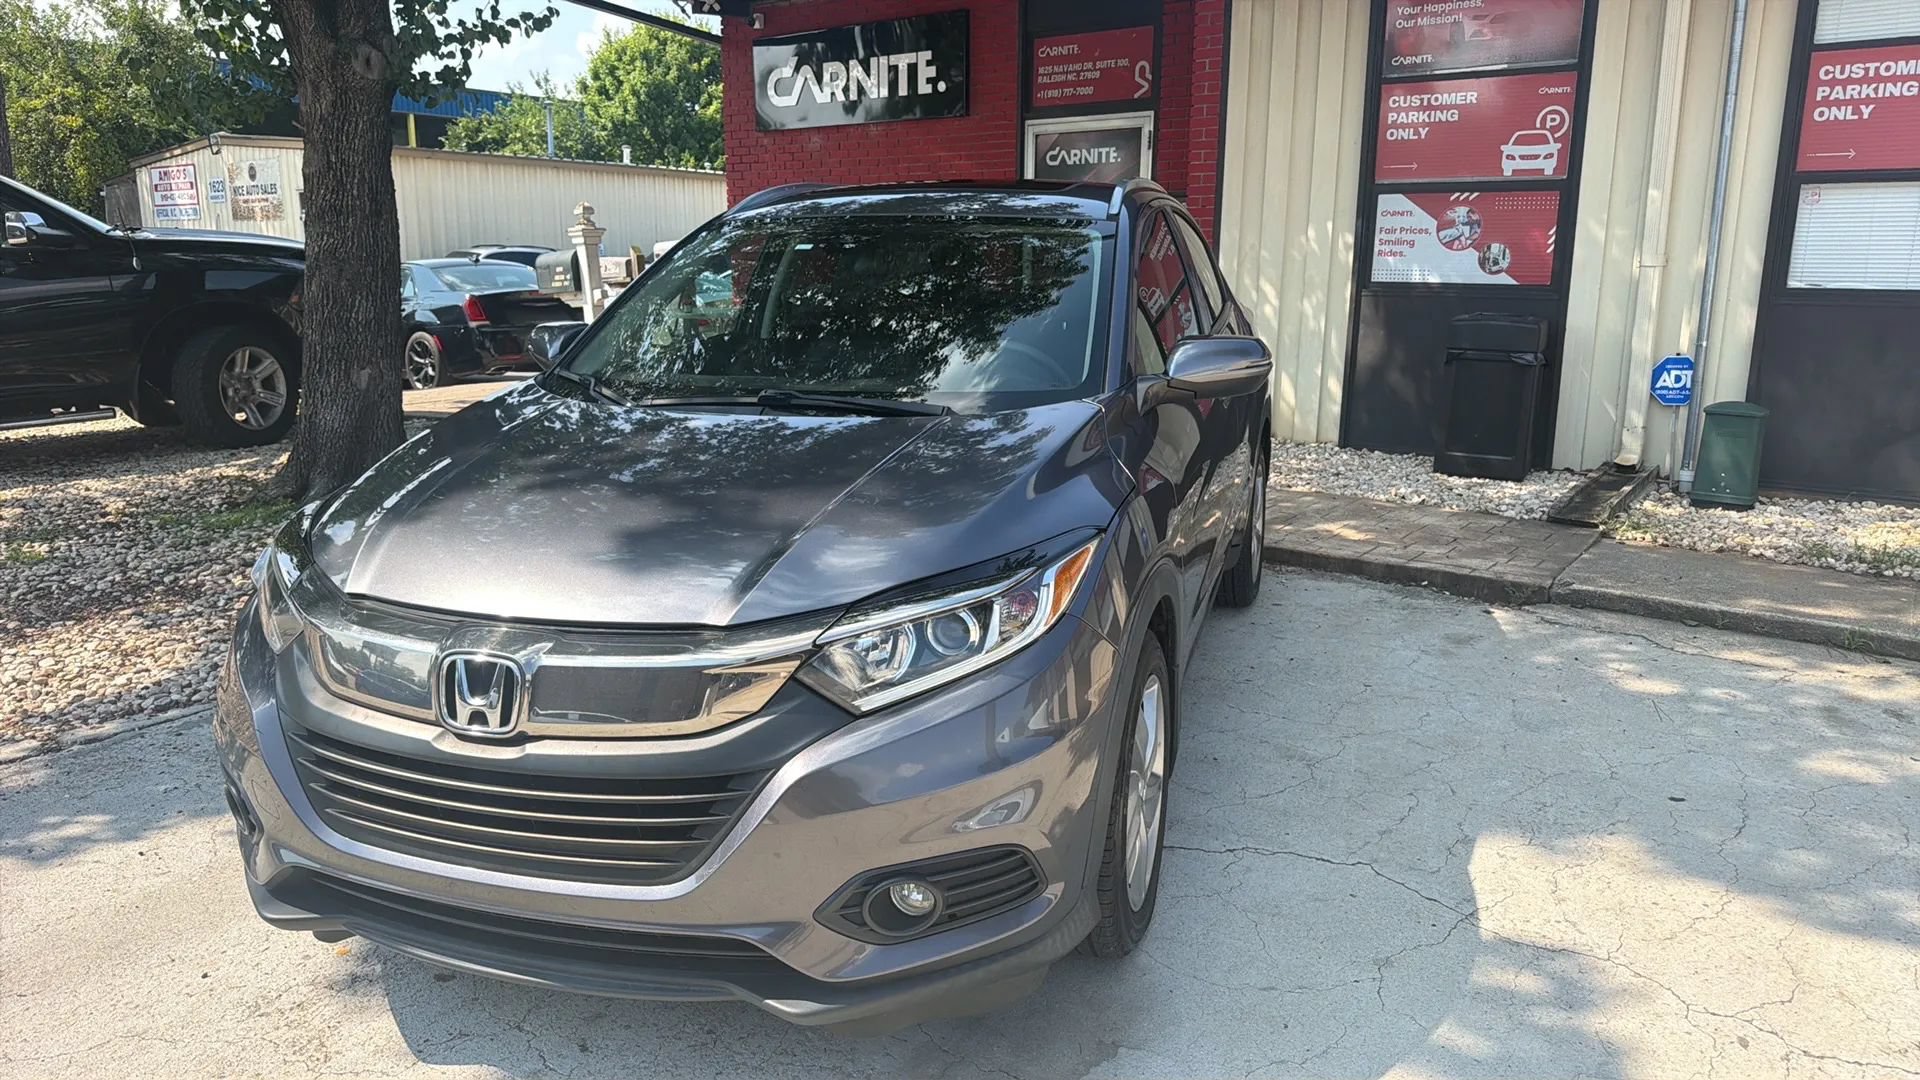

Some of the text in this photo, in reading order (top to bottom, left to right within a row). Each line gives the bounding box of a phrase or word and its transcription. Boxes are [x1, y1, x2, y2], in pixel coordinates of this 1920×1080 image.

[1397, 0, 1485, 15] Your Happiness,
[1396, 12, 1462, 28] Our Mission!
[1038, 44, 1081, 57] CARNITE.
[1053, 63, 1082, 73] NAVAHO
[1096, 59, 1117, 69] SUITE
[767, 50, 947, 107] CARNITE.
[1038, 74, 1067, 84] RALEIGH
[1816, 81, 1919, 101] PARKING
[1389, 91, 1478, 108] CUSTOMER
[1387, 109, 1459, 125] PARKING
[1813, 104, 1876, 122] ONLY
[1386, 127, 1430, 141] ONLY
[1046, 146, 1121, 166] CARNITE.
[158, 168, 187, 182] AMIGO'S
[208, 180, 225, 193] 1623
[246, 184, 260, 196] AUTO
[260, 183, 277, 195] SALES
[1379, 225, 1432, 236] Fair Prices,
[1378, 237, 1415, 248] Smiling
[1377, 248, 1407, 257] Rides.
[1654, 370, 1694, 388] ADT
